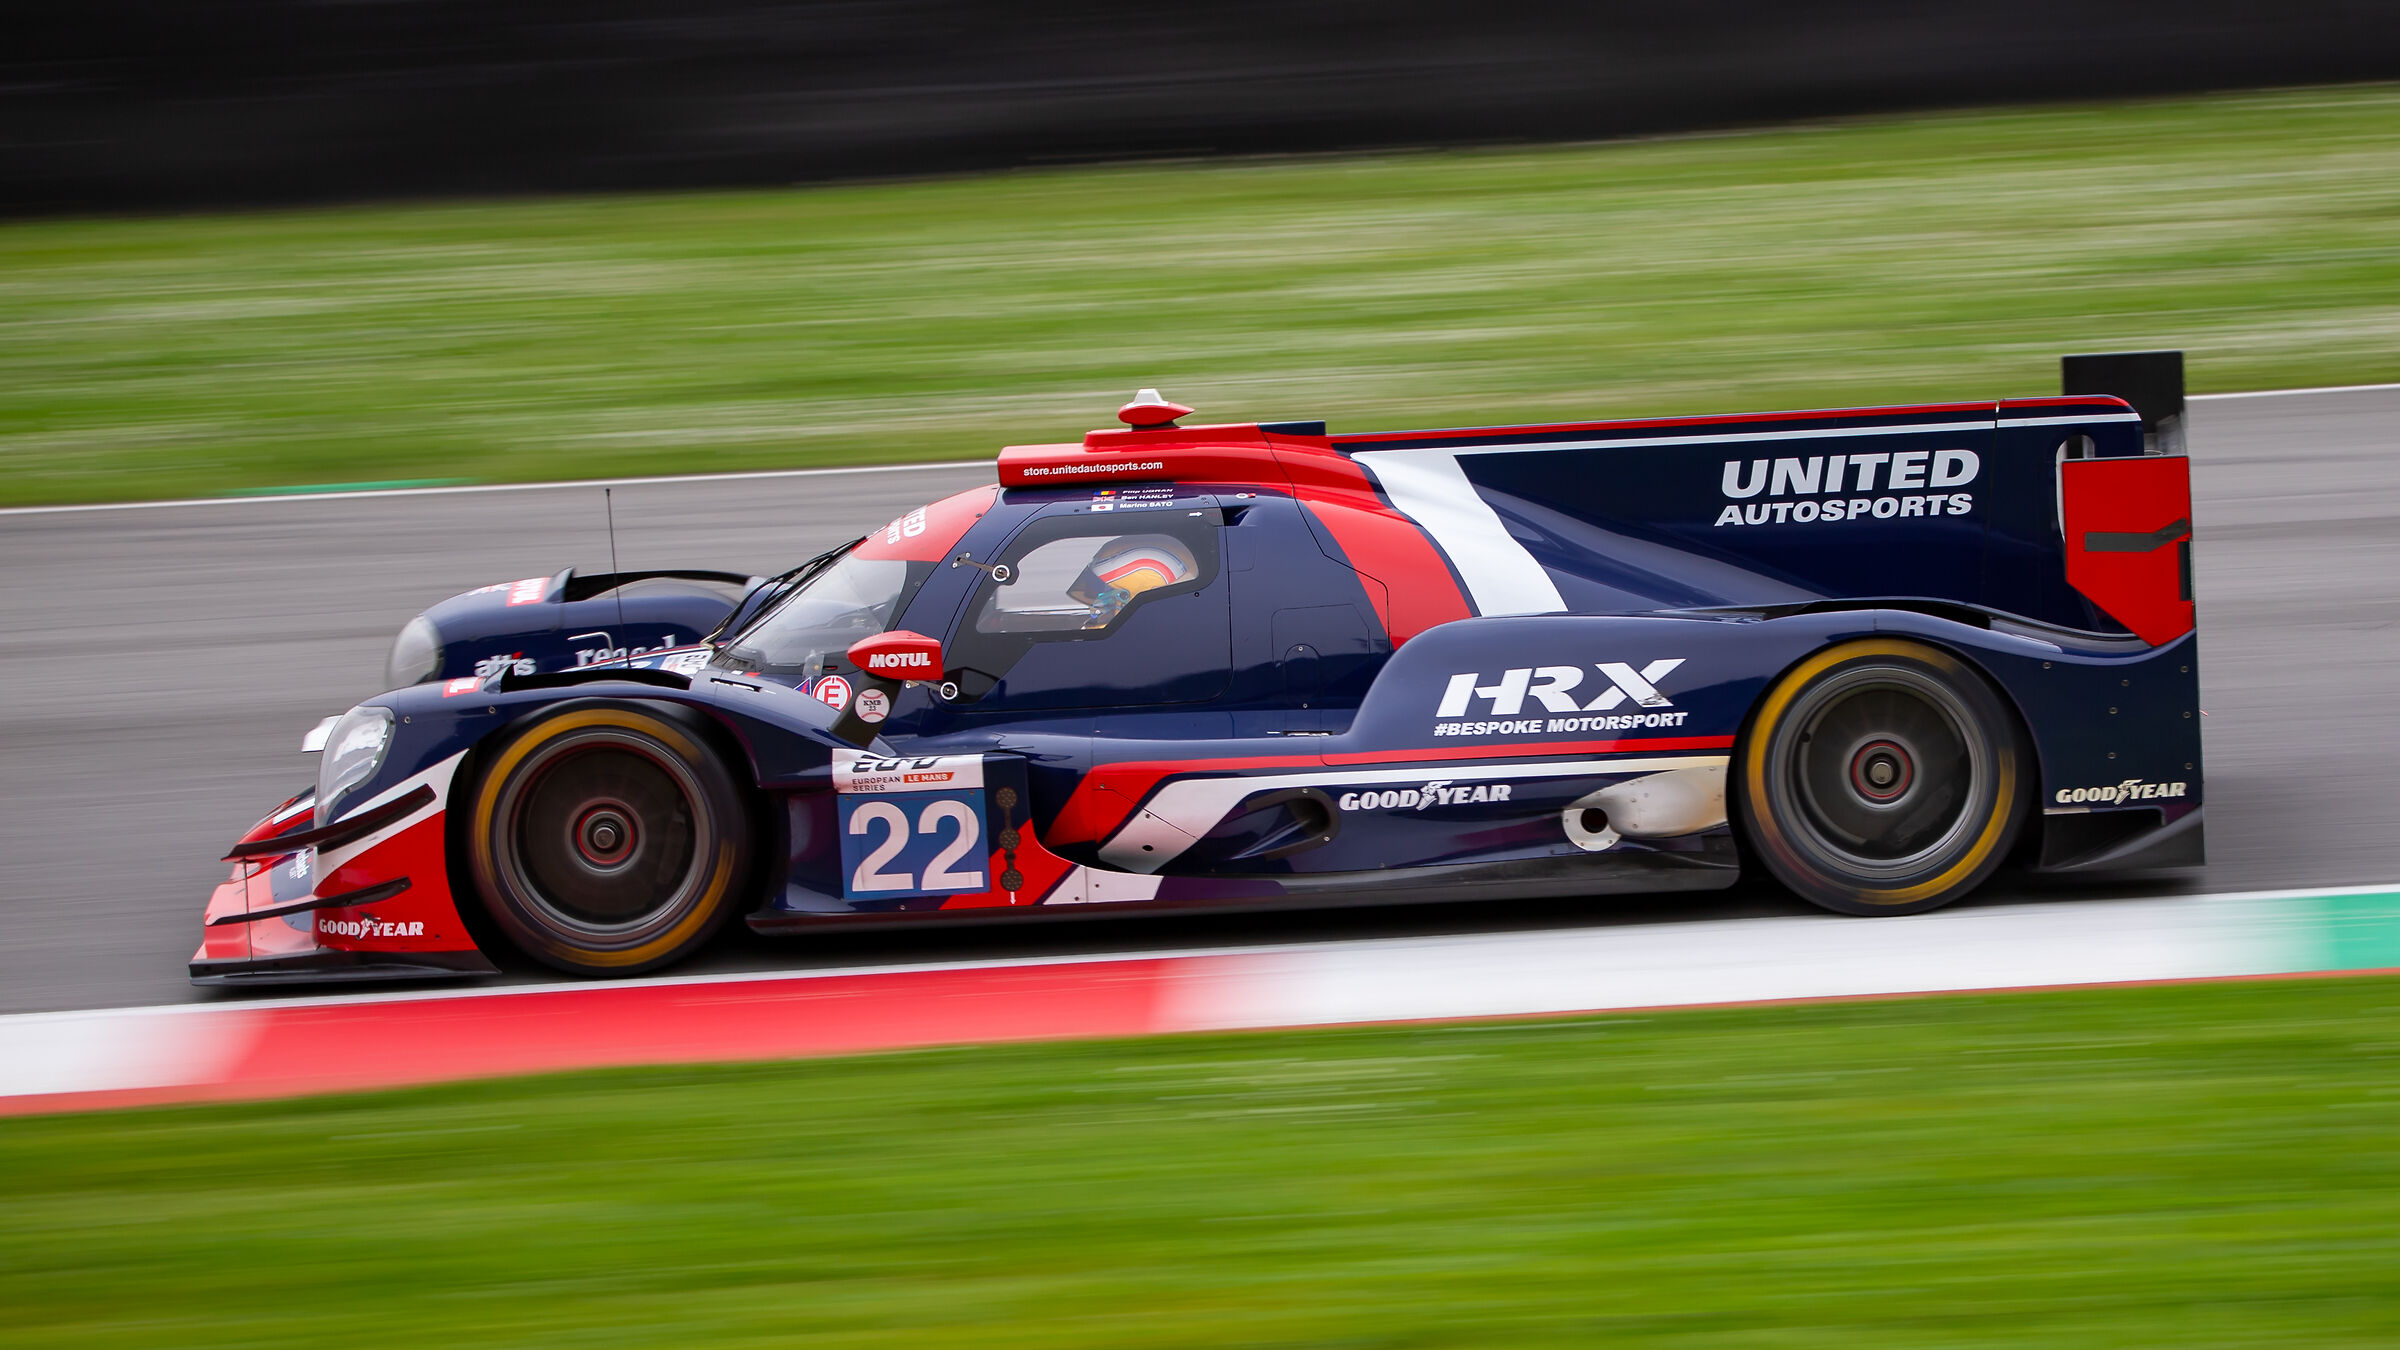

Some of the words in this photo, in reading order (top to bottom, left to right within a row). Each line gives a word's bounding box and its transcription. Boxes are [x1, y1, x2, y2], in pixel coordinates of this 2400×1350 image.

[1023, 461, 1163, 477] store.unitedautosports.com
[1721, 449, 1980, 498] UNITED
[1713, 493, 1973, 527] AUTOSPORTS
[868, 652, 931, 668] MOTUL
[1435, 658, 1687, 718] HRX
[863, 699, 882, 707] KMB
[1433, 718, 1542, 737] #BESPOKE
[1546, 712, 1689, 733] MOTORSPORT
[852, 776, 900, 785] EUROPEAN
[908, 774, 920, 782] LE
[922, 773, 948, 782] MANS
[853, 784, 886, 792] SERIES
[1338, 780, 1512, 811] GOODYEAR
[2055, 779, 2187, 805] GOODYEAR
[849, 800, 984, 892] 22
[318, 918, 424, 940] GOODYEAR
